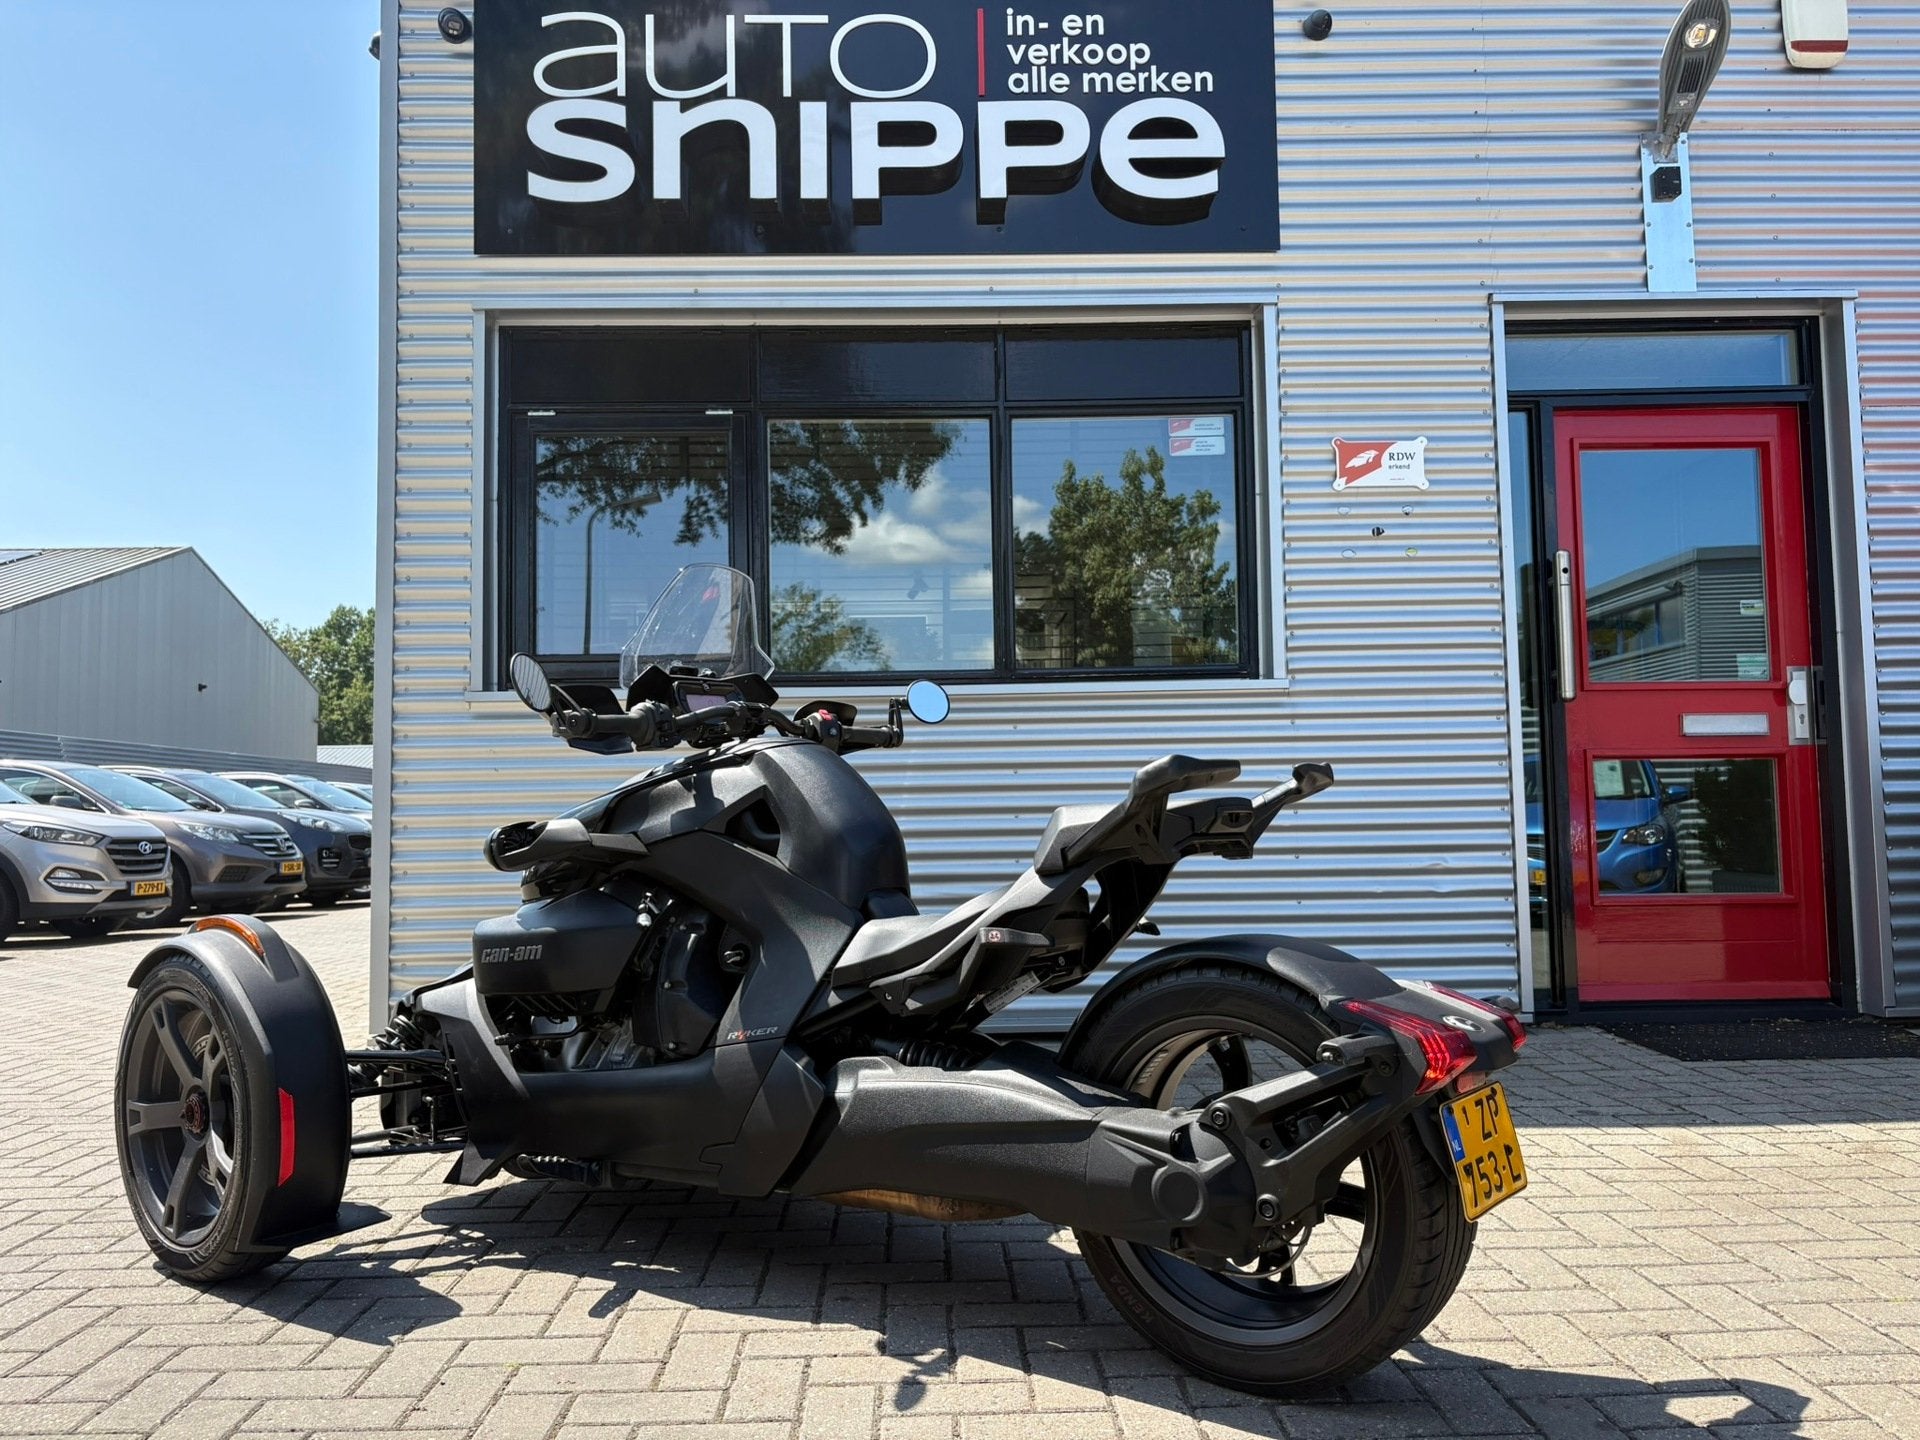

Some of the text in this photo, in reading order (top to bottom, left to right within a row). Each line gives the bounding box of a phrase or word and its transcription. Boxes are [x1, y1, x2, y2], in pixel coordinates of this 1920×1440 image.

[1006, 7, 1105, 36] in- en
[1006, 36, 1151, 71] verkoop
[1007, 65, 1214, 94] alle merken
[1388, 451, 1416, 461] RDW
[480, 944, 543, 964] can-am
[726, 1025, 779, 1040] RYKER
[1474, 1086, 1499, 1142] ZP
